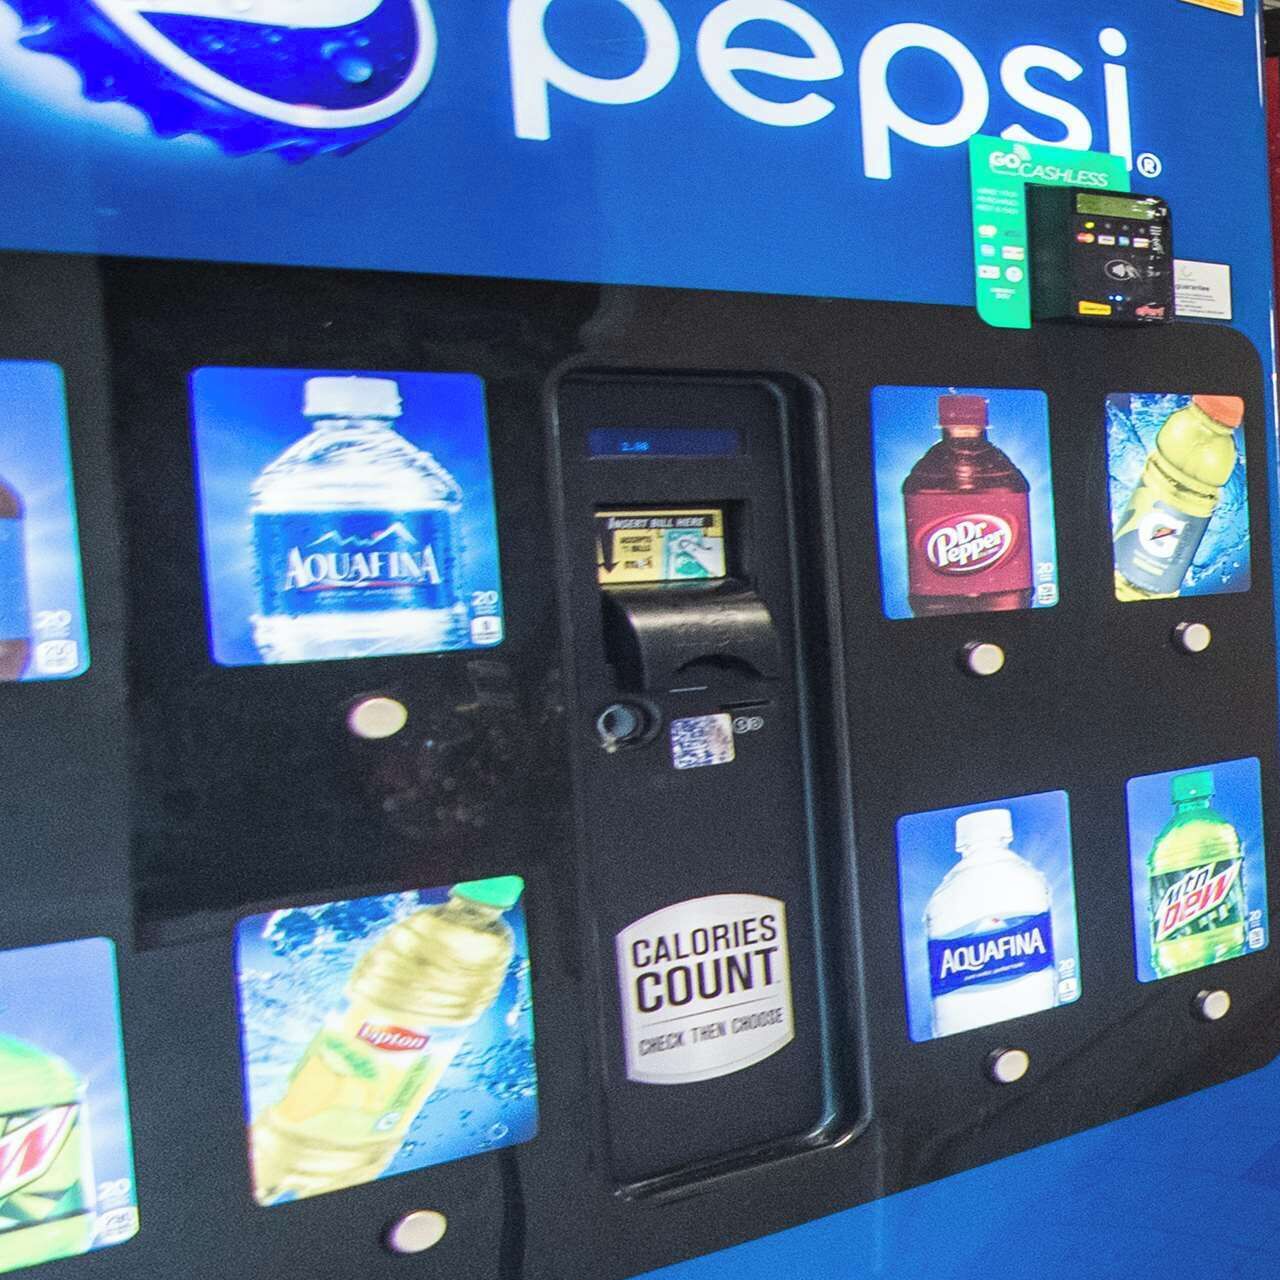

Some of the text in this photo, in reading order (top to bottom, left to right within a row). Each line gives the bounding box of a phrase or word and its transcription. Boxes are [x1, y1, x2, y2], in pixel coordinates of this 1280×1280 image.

[507, 0, 1135, 180] pepsi
[989, 151, 1110, 187] GO CASHLESS
[608, 516, 706, 529] INSERT BILL HERE
[956, 520, 988, 542] Dr
[283, 543, 443, 592] AQUAFINA
[927, 525, 1007, 568] Pepper
[469, 590, 499, 606] 20
[631, 914, 778, 968] CALORIES
[940, 927, 1047, 980] AQUAFINA
[636, 945, 779, 1014] COUNT
[360, 1023, 428, 1050] Lipton
[638, 1007, 784, 1057] CHECK THEN CHOOSE
